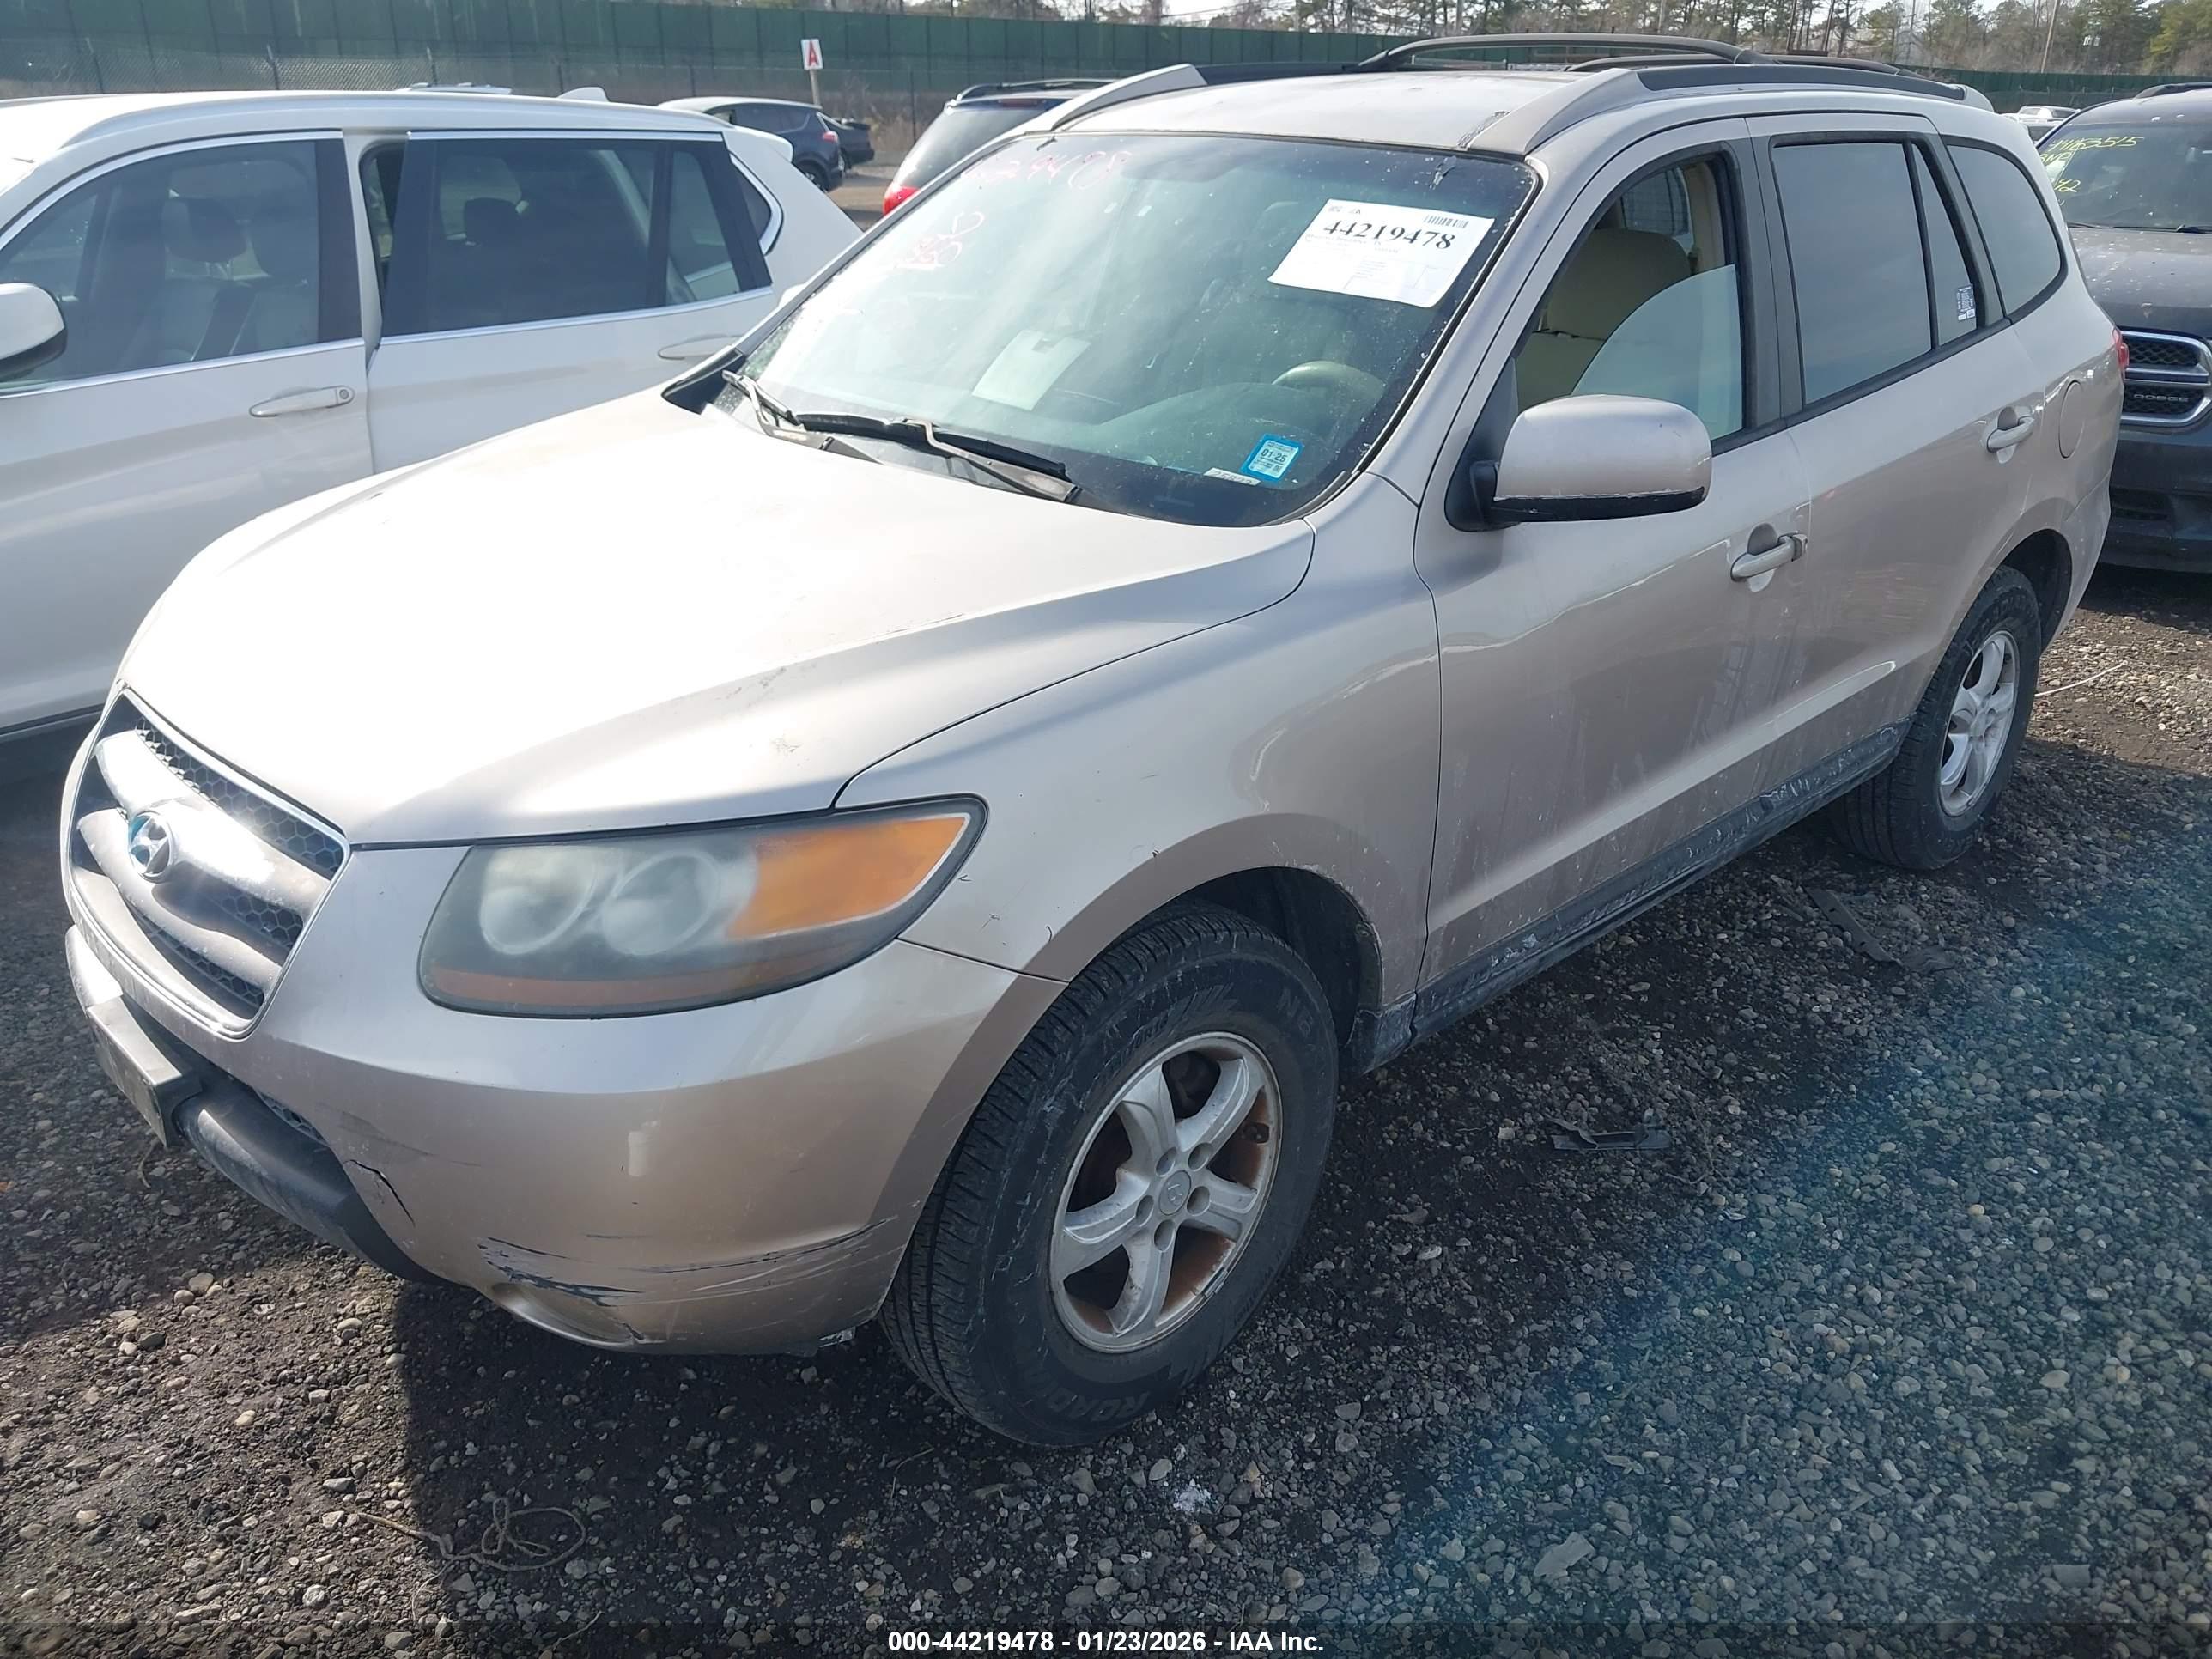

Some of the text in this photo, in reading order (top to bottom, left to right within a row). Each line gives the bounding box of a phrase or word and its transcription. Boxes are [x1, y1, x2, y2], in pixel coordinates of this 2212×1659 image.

[808, 40, 819, 66] A
[1323, 220, 1455, 249] 44219478
[2134, 393, 2190, 403] DODGE
